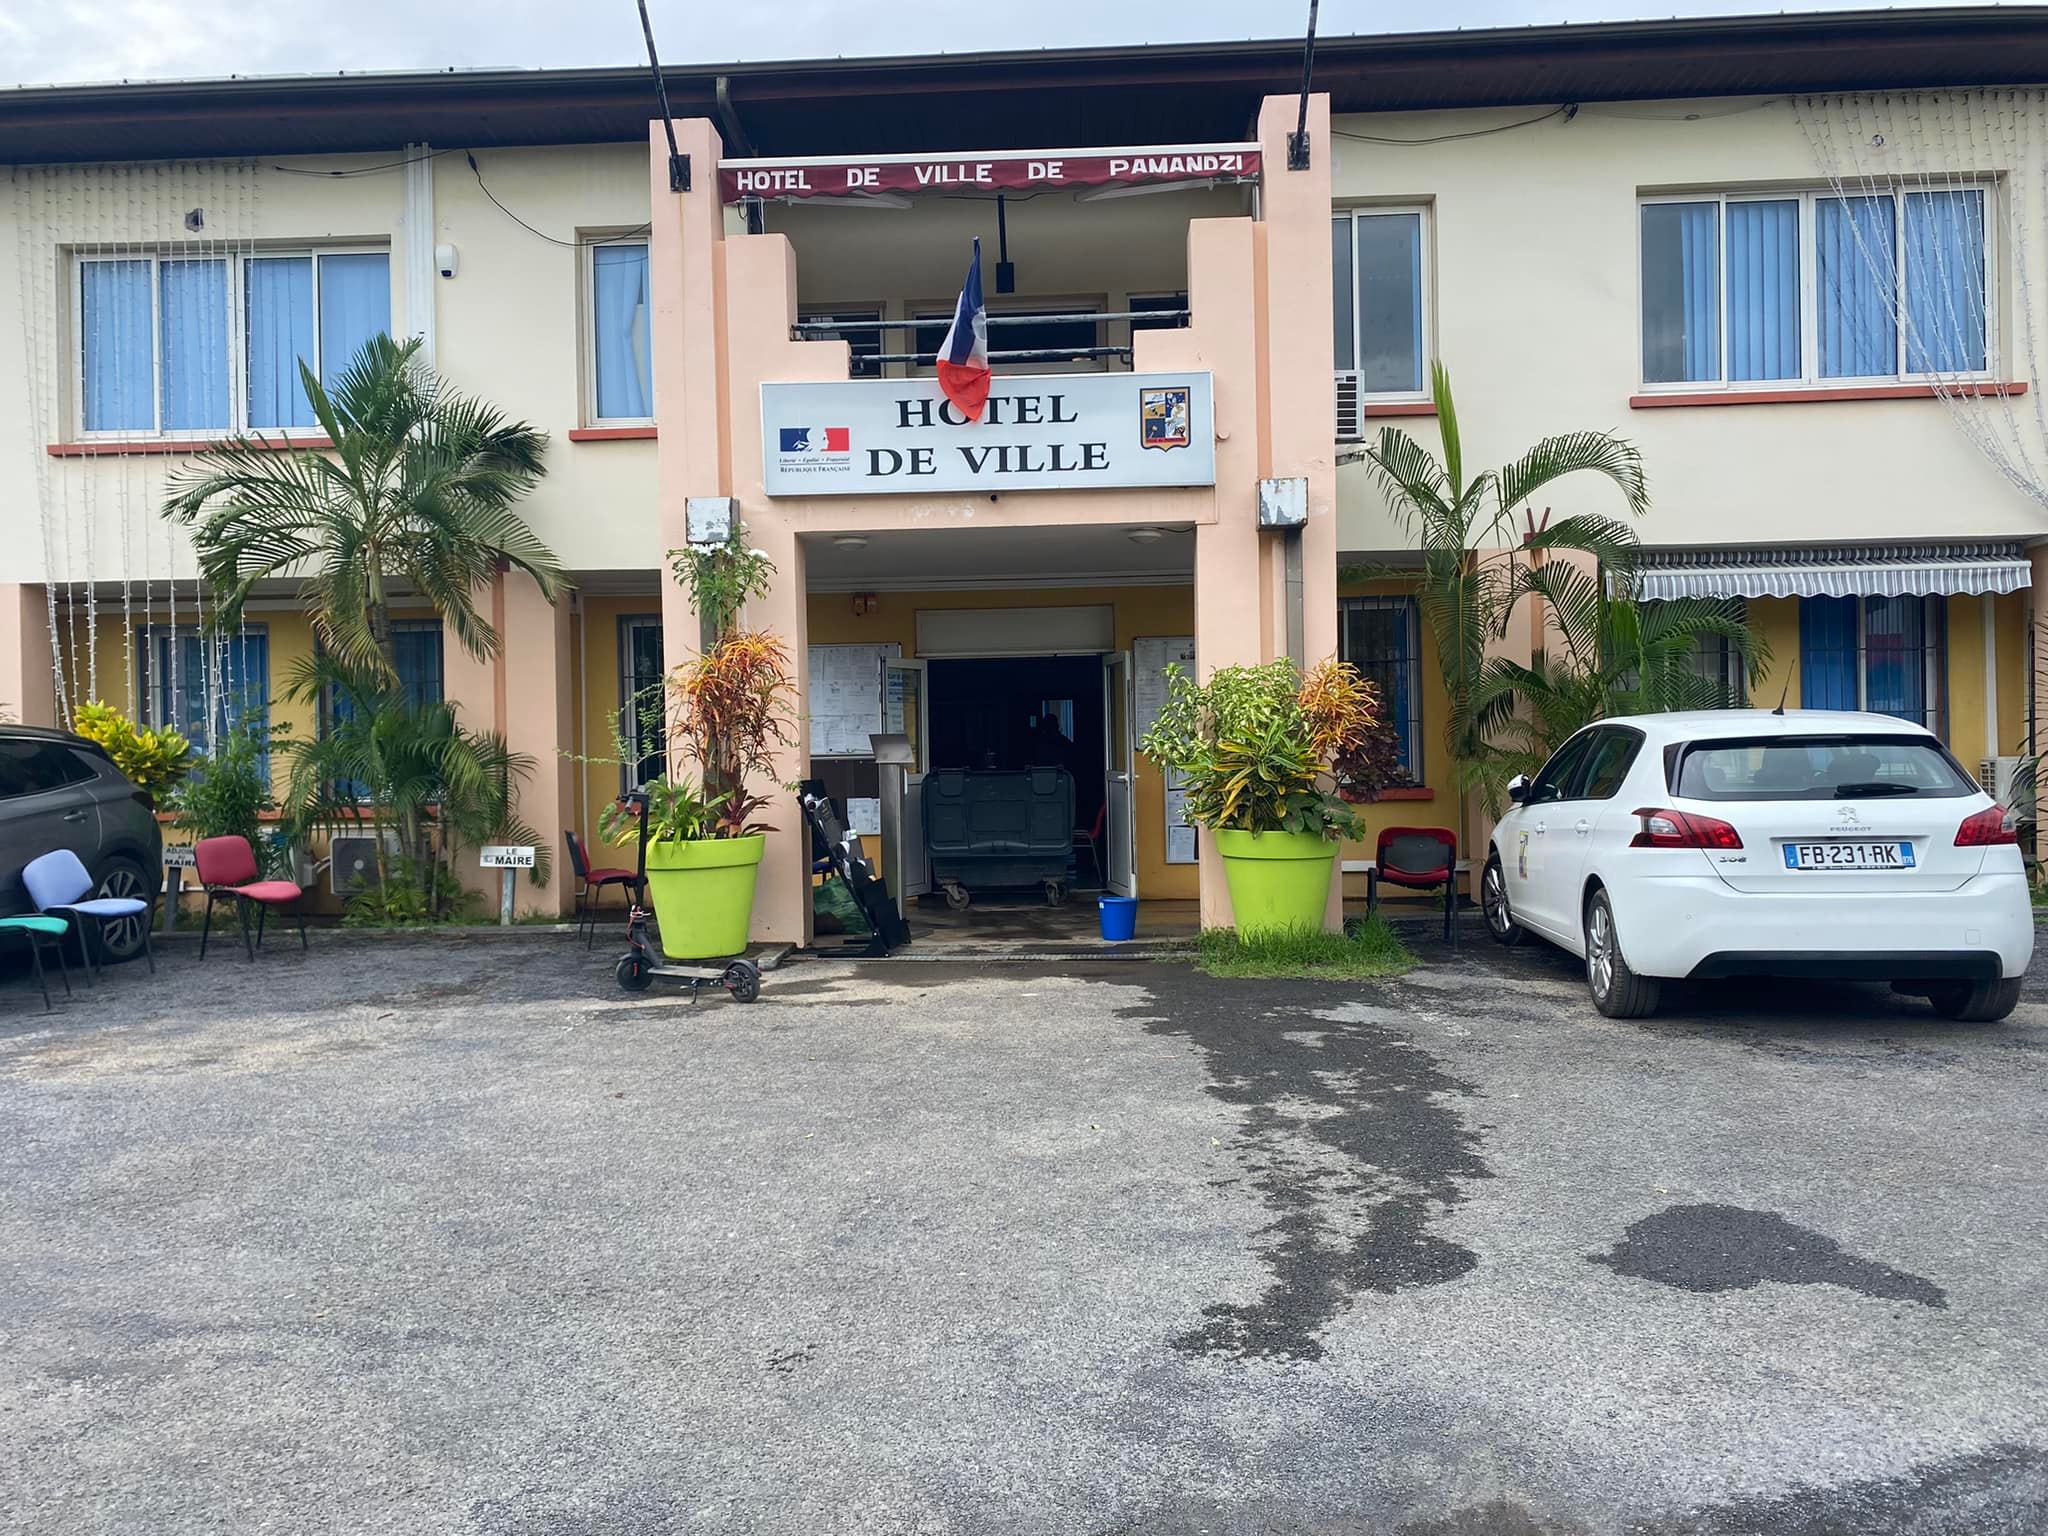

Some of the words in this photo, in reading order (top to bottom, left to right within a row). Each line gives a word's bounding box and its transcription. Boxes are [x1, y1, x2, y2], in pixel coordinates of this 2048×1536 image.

[736, 169, 812, 191] HOTEL
[847, 167, 880, 187] DE
[914, 163, 993, 185] VILLE
[1027, 161, 1064, 180] DE
[1109, 154, 1243, 177] PAMANDZI
[865, 447, 938, 477] DE
[956, 442, 1110, 474] VILLE
[495, 856, 532, 865] MAIRE
[506, 847, 518, 855] LE
[1800, 845, 1897, 864] FB-231-RK
